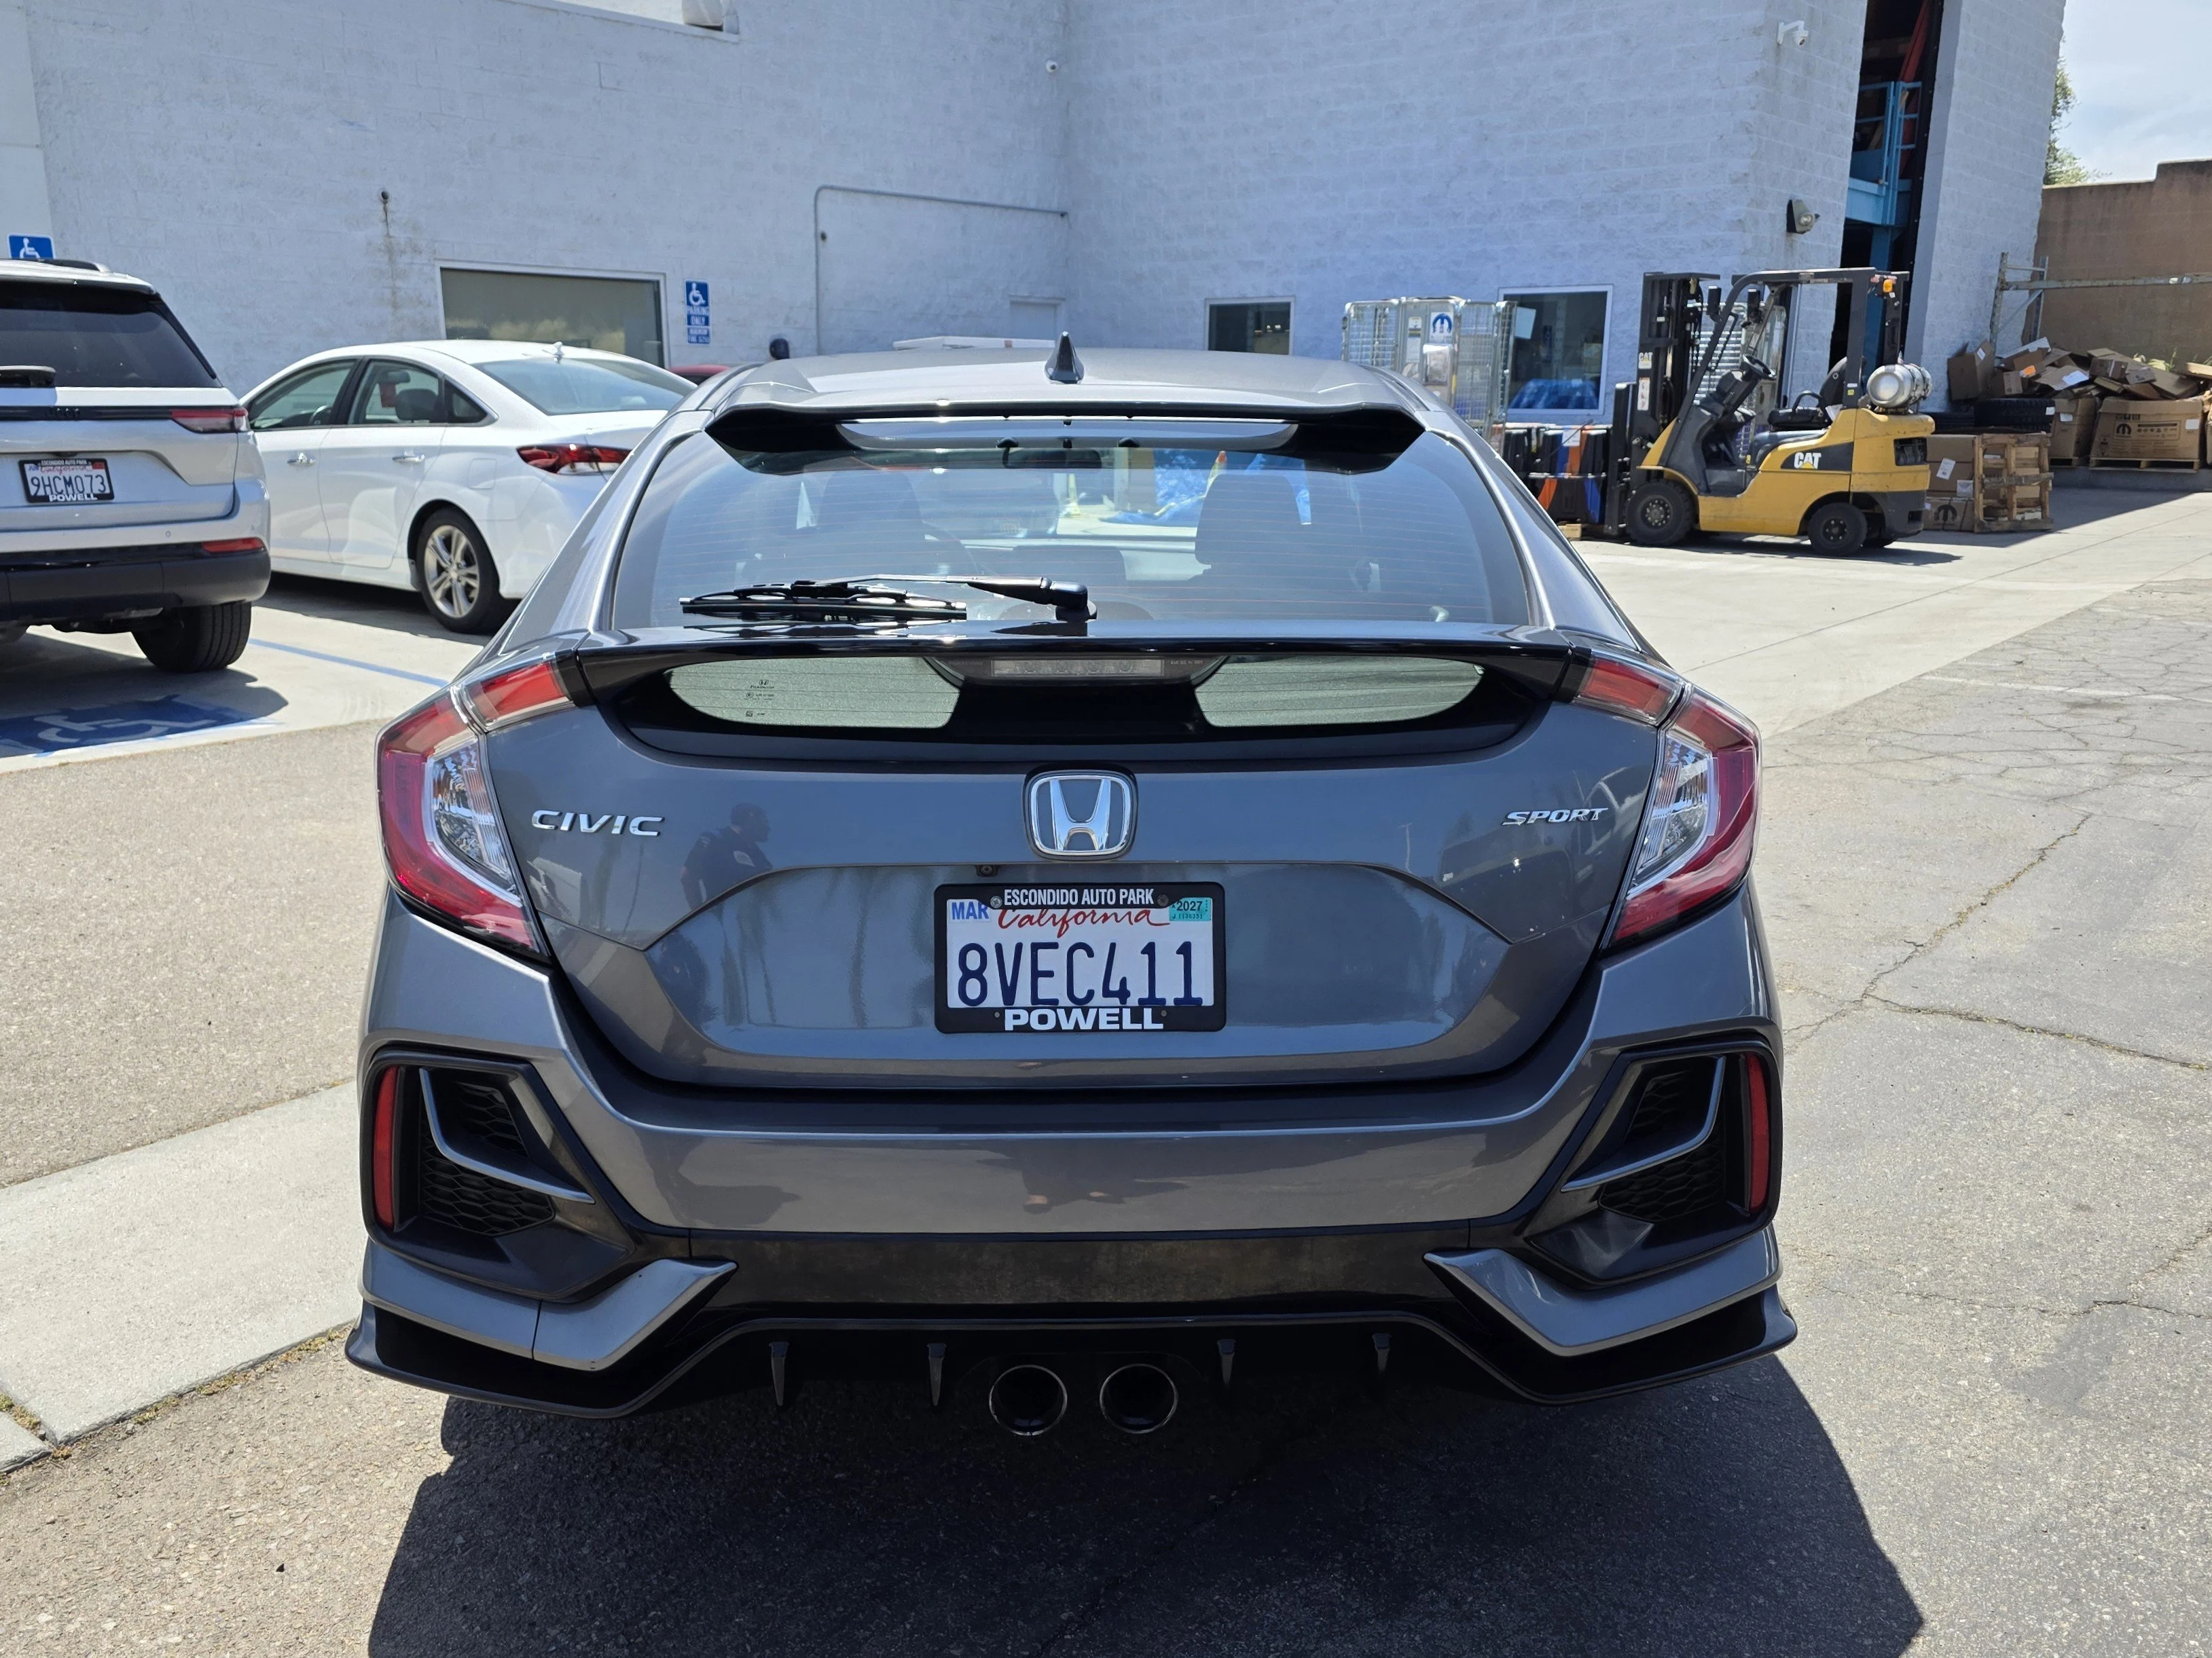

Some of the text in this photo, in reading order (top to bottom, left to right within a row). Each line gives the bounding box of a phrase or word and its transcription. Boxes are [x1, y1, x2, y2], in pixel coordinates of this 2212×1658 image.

[1638, 352, 1653, 362] CAT
[1794, 452, 1821, 469] CAT
[31, 474, 107, 496] 9HCM073
[49, 493, 98, 502] POWELL
[531, 809, 664, 836] CIVIC
[1502, 807, 1609, 826] SPORT
[1004, 888, 1155, 906] ESCONDIDO AUTO PARK
[1176, 900, 1203, 911] 2027
[951, 902, 990, 920] MAR
[997, 908, 1171, 938] California
[958, 941, 1203, 1006] 8VEC411
[1004, 1008, 1163, 1031] POWELL
